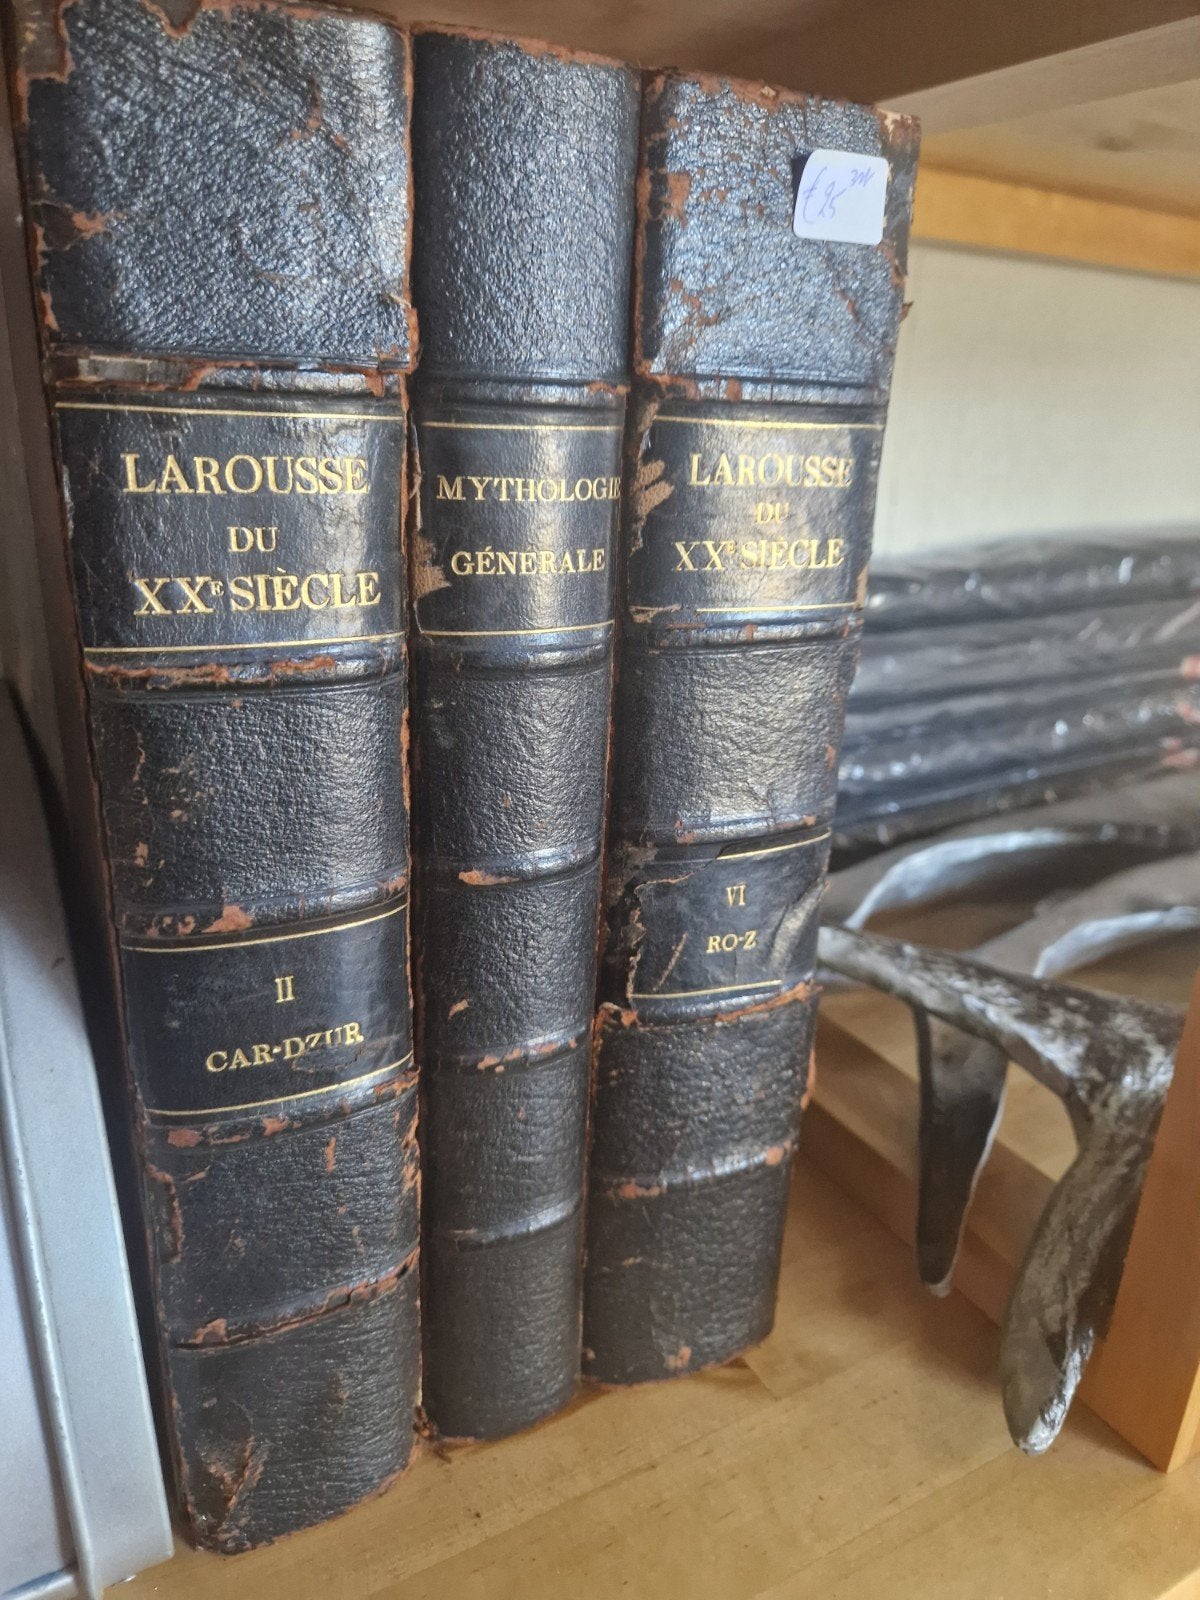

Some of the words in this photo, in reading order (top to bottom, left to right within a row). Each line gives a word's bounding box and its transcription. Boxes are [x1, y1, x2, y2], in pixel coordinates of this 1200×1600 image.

[119, 453, 370, 495] LAROUSSE
[689, 452, 854, 488] LAROUSSE
[436, 475, 621, 501] MYTHOLOGIE
[756, 501, 790, 525] DU
[227, 526, 278, 553] DU
[739, 537, 845, 571] SIÈCLE
[451, 546, 606, 575] GÉNÉRALE
[230, 566, 381, 612] SIÈCLE
[726, 882, 747, 907] VI
[705, 930, 757, 954] RO-Z
[274, 975, 296, 1004] II
